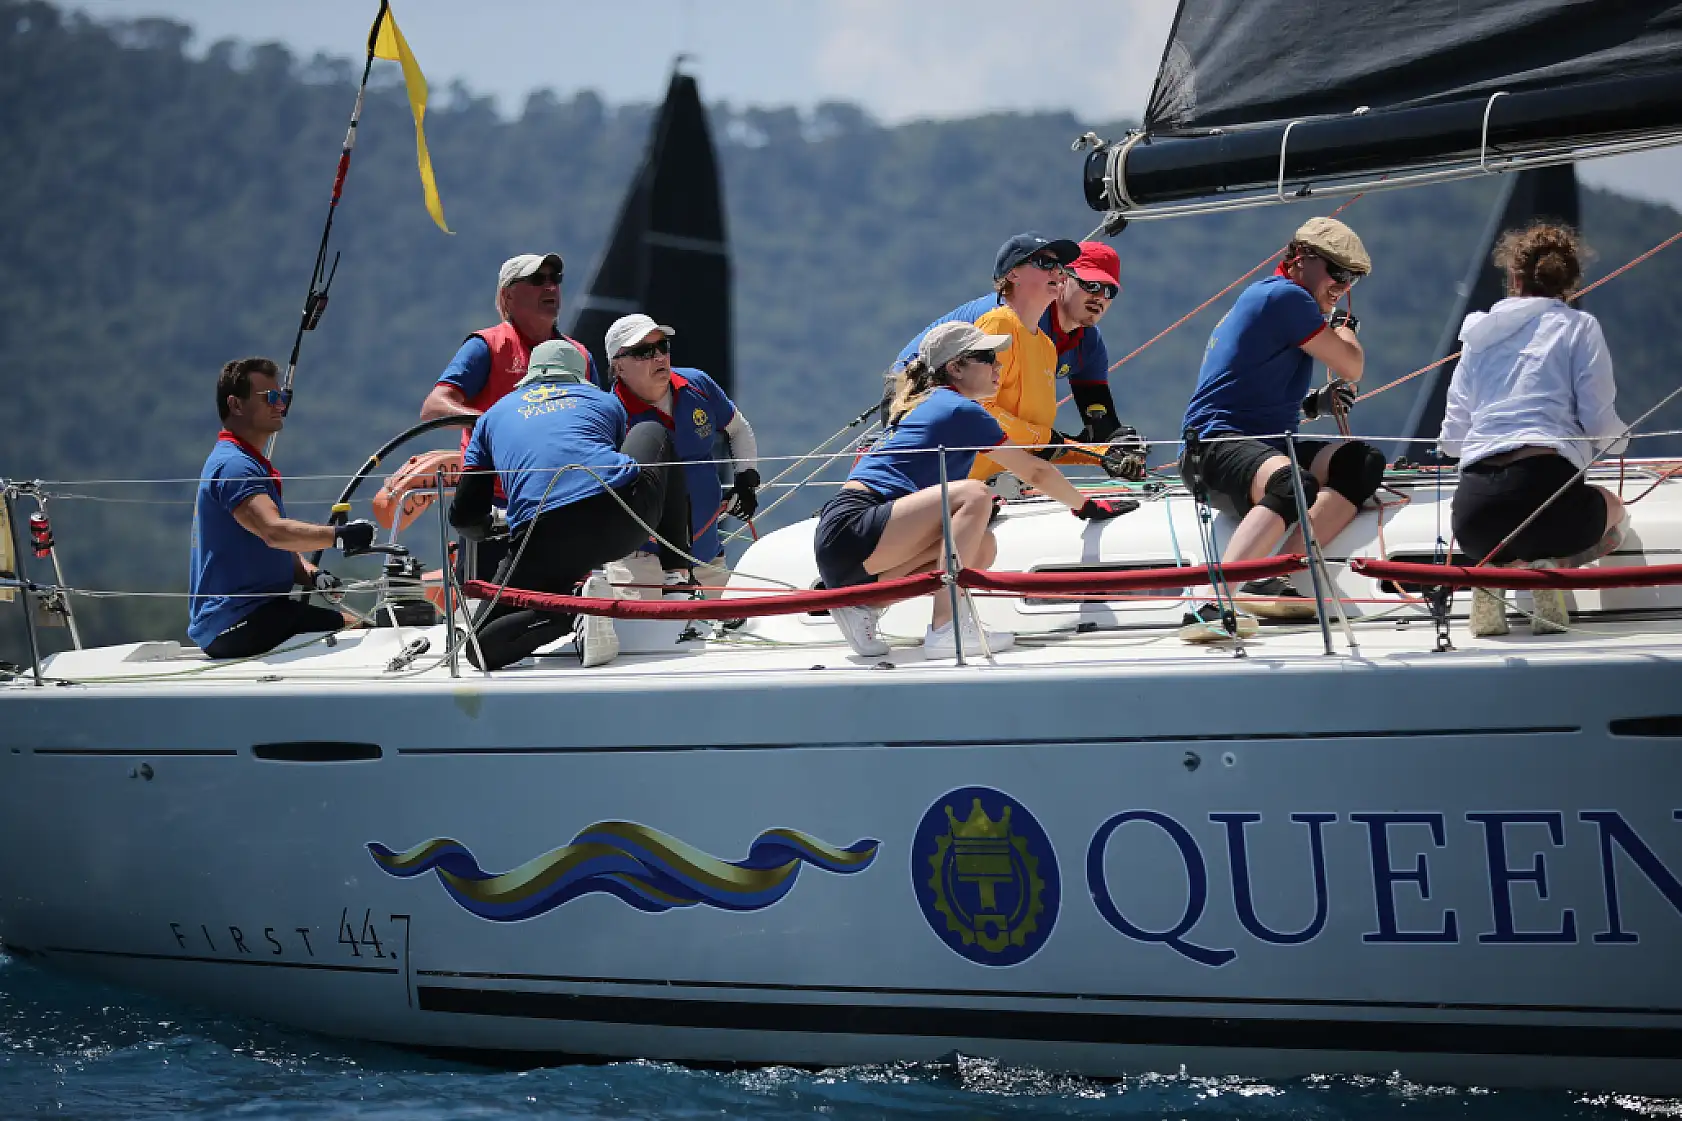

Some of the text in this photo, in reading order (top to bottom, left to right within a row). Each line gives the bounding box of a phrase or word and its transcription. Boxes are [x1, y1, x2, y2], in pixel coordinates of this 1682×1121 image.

[1086, 808, 1682, 967] QUEEN
[170, 906, 412, 1008] FIRST 44.7
